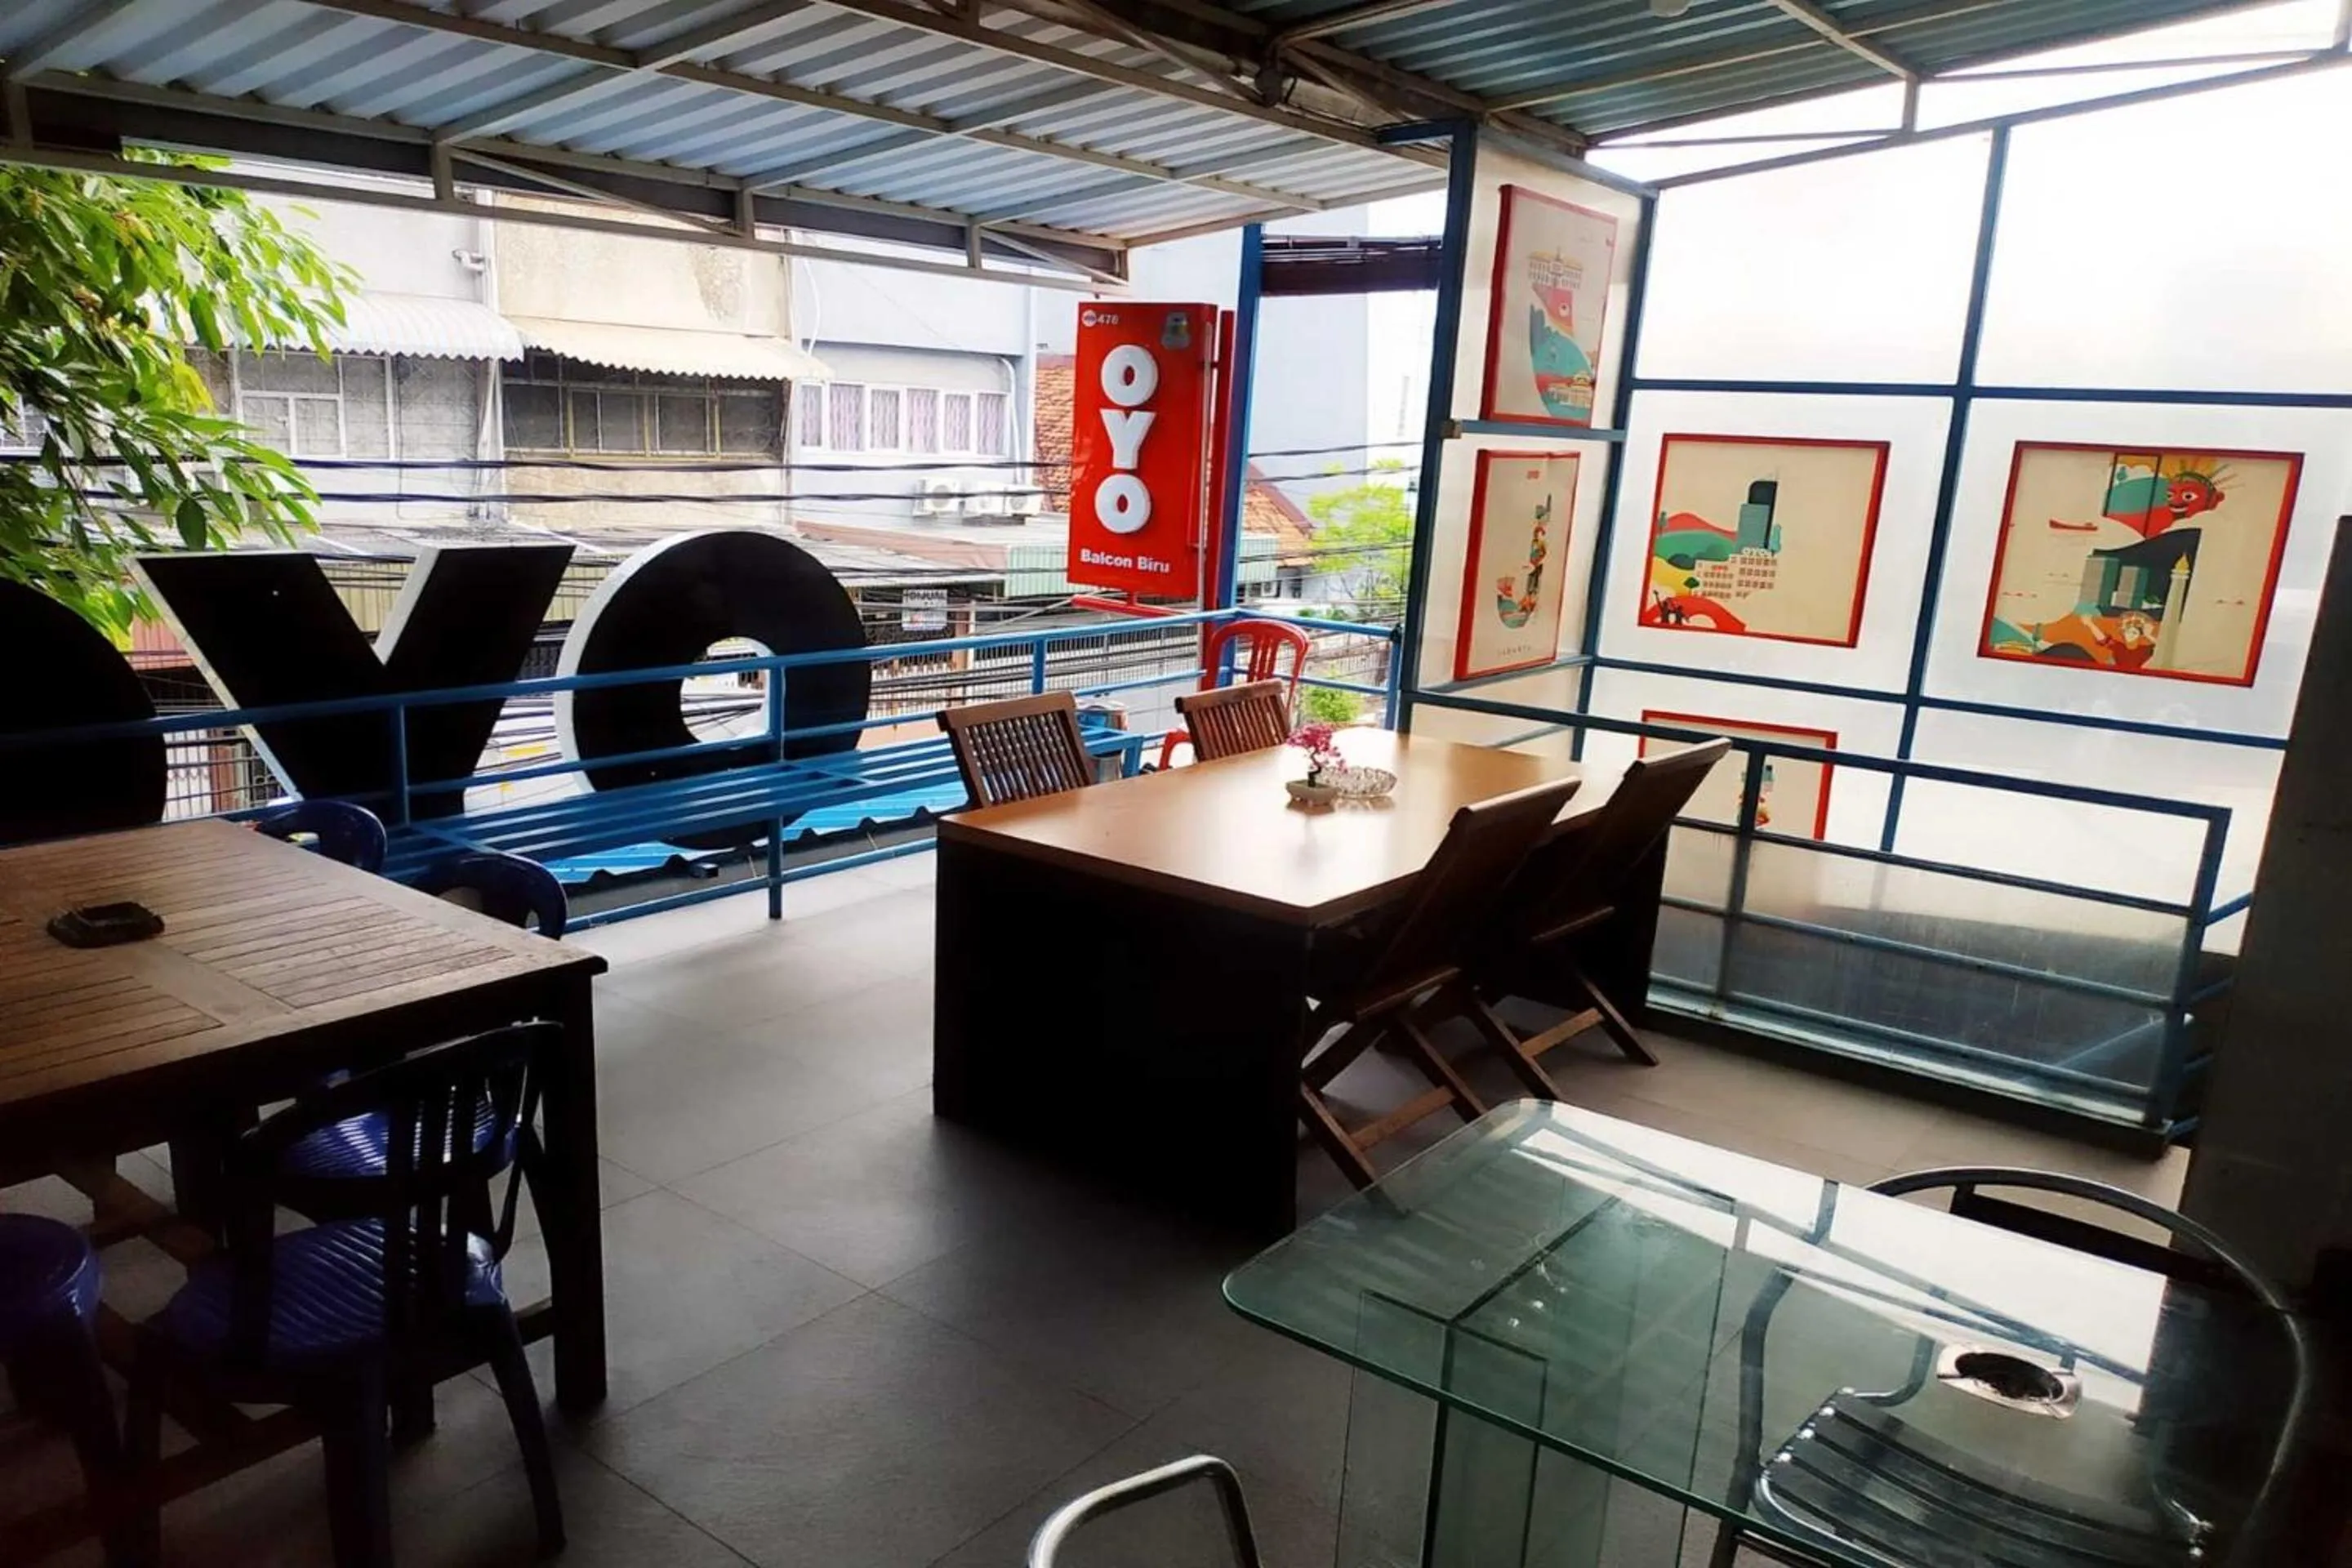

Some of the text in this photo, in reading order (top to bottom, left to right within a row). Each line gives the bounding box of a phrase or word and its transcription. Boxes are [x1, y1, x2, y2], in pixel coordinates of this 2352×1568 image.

[1095, 345, 1158, 533] OYO
[1080, 548, 1170, 573] Balcon Biru
